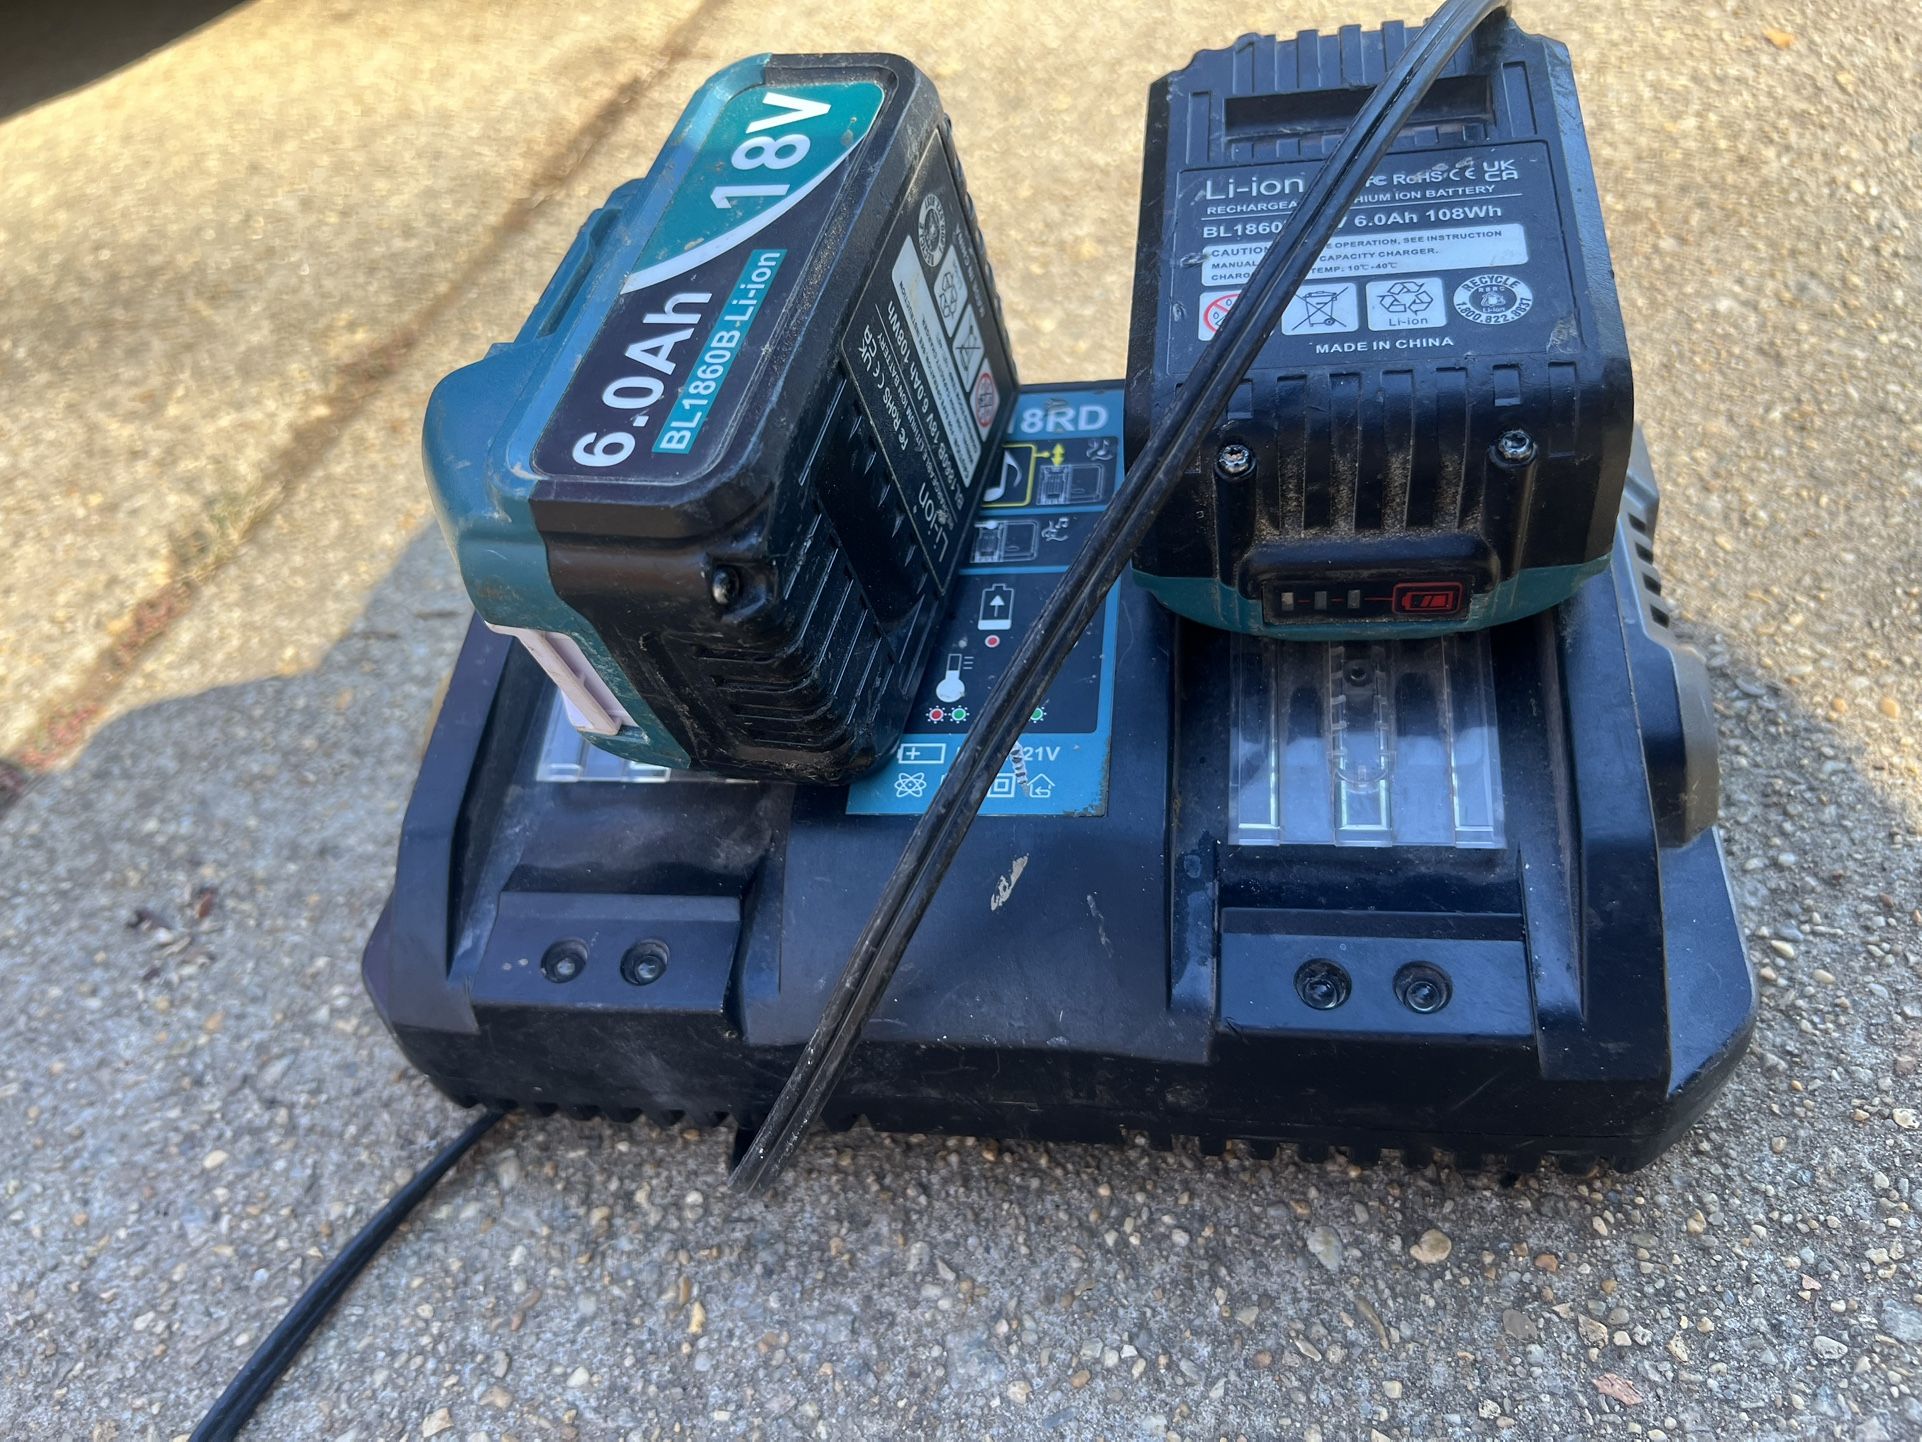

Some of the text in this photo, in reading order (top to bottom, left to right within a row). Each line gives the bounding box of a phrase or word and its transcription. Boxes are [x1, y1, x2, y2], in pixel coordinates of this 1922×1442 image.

[710, 92, 832, 209] 18V
[1393, 169, 1443, 185] RoHS
[1483, 160, 1515, 171] UK
[1485, 170, 1519, 182] CA
[1206, 177, 1305, 200] Li-ion
[1207, 185, 1496, 215] RECHARGEA HIUM ION BATTERY
[1203, 221, 1287, 238] BL1860
[1354, 212, 1418, 228] 6.0Ah
[1426, 205, 1502, 222] 108Wh
[1334, 238, 1401, 249] OPERATION,
[1403, 236, 1424, 244] SEE
[1426, 230, 1503, 242] INSTRUCTION
[1319, 252, 1376, 262] CAPACITY
[1378, 248, 1439, 258] CHARGER.
[1461, 275, 1521, 292] RECYCLE
[1388, 316, 1429, 327] Li-ion
[1455, 297, 1532, 324] 1.800.822.8837
[887, 300, 911, 364] 108Wh
[1315, 336, 1455, 354] MADE IN CHINA
[877, 331, 900, 388] BATTERY
[572, 293, 712, 467] 6.0Ah
[659, 330, 741, 450] BL1860B
[909, 361, 929, 414] 6.0Ah
[882, 387, 901, 431] RoHS
[897, 384, 908, 409] ION
[926, 412, 940, 443] 18V
[919, 482, 949, 562] Li-ion
